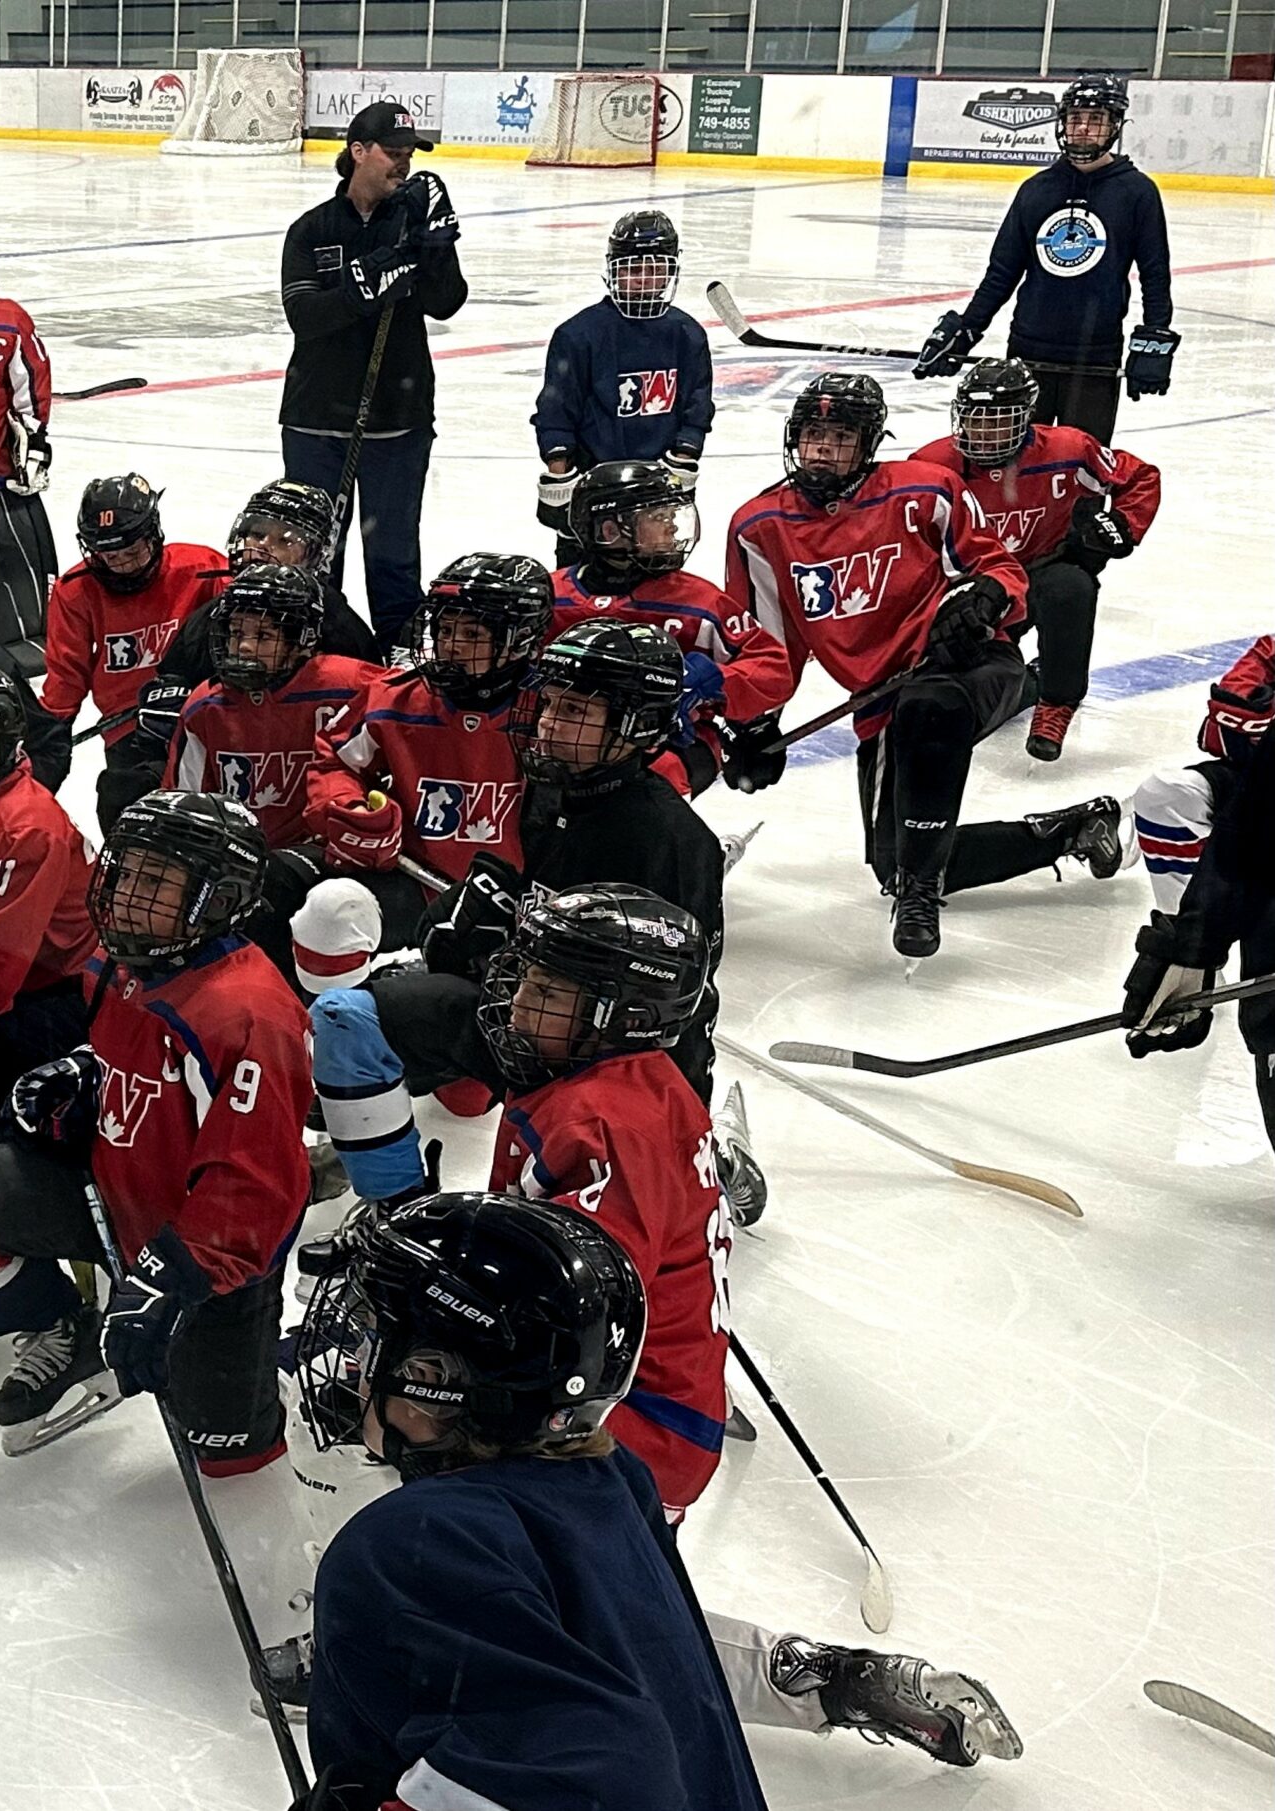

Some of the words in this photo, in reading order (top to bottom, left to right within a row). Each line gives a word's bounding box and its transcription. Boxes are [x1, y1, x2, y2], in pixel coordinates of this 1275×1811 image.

[706, 79, 741, 89] Excavating
[706, 88, 733, 97] Trucking
[316, 93, 363, 116] LAKE
[705, 97, 731, 106] Logging
[699, 116, 751, 130] 749-4855
[979, 106, 1052, 125] ISHERWOOD
[924, 149, 963, 158] REPAIRING
[965, 150, 980, 159] THE
[981, 151, 1024, 161] COWICHAN
[1026, 152, 1054, 162] VALLEY
[617, 368, 678, 418] BW
[1052, 474, 1066, 499] C
[591, 501, 616, 511] CCM
[99, 511, 113, 527] 10
[905, 500, 919, 533] C
[986, 506, 1046, 552] W
[790, 543, 901, 622] BW
[216, 750, 316, 808] BW
[414, 776, 522, 844] BW
[904, 818, 948, 831] CCM
[629, 961, 676, 981] BAUER
[229, 1059, 262, 1114] 9
[425, 1284, 496, 1329] BAUER
[403, 1383, 465, 1403] BAUER
